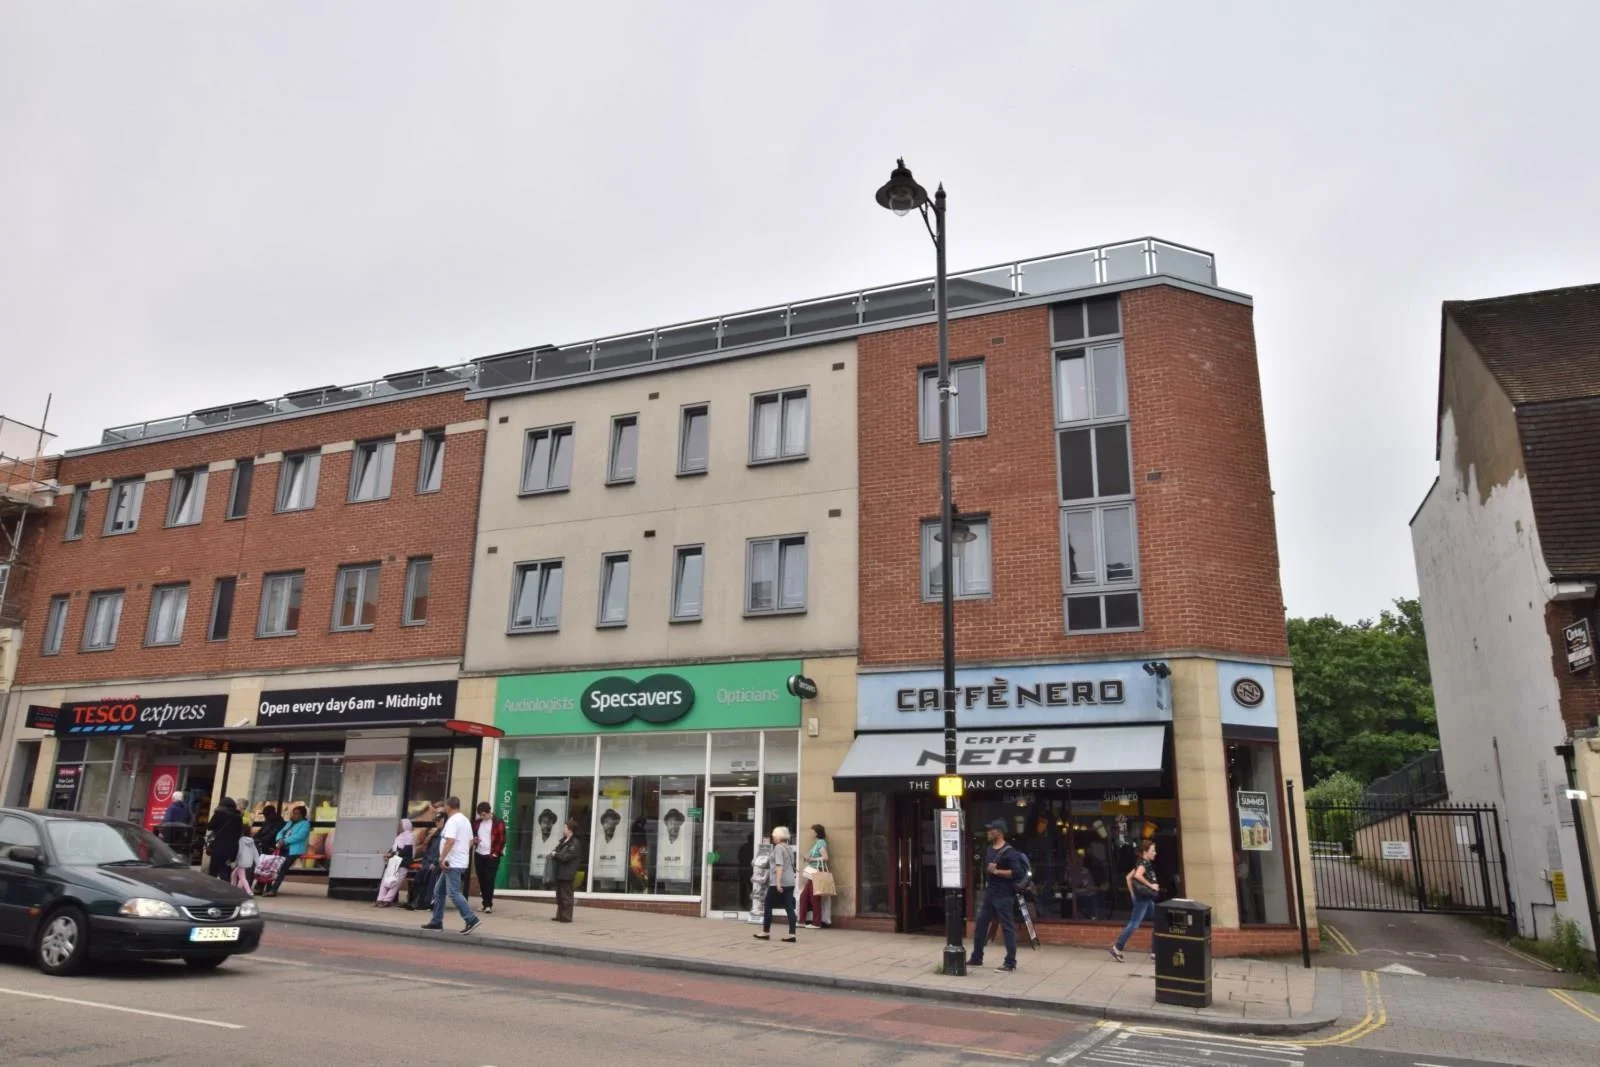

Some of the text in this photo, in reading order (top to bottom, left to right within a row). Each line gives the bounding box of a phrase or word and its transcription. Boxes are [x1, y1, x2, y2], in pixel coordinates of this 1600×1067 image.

[590, 690, 682, 712] Specsavers
[716, 687, 780, 704] Opticians
[896, 676, 1009, 711] CAFÈ
[1017, 680, 1126, 708] NERO
[259, 701, 290, 716] Open
[292, 700, 324, 714] every
[326, 698, 347, 714] day
[348, 697, 375, 710] 6am
[386, 692, 442, 710] Midnight
[503, 697, 575, 714] Audiologists
[72, 703, 138, 724] TESCO
[140, 702, 207, 727] express
[965, 734, 1037, 744] CAFFÈ
[916, 746, 1077, 766] NERO
[909, 781, 930, 790] THE
[995, 778, 1046, 788] COFFEE
